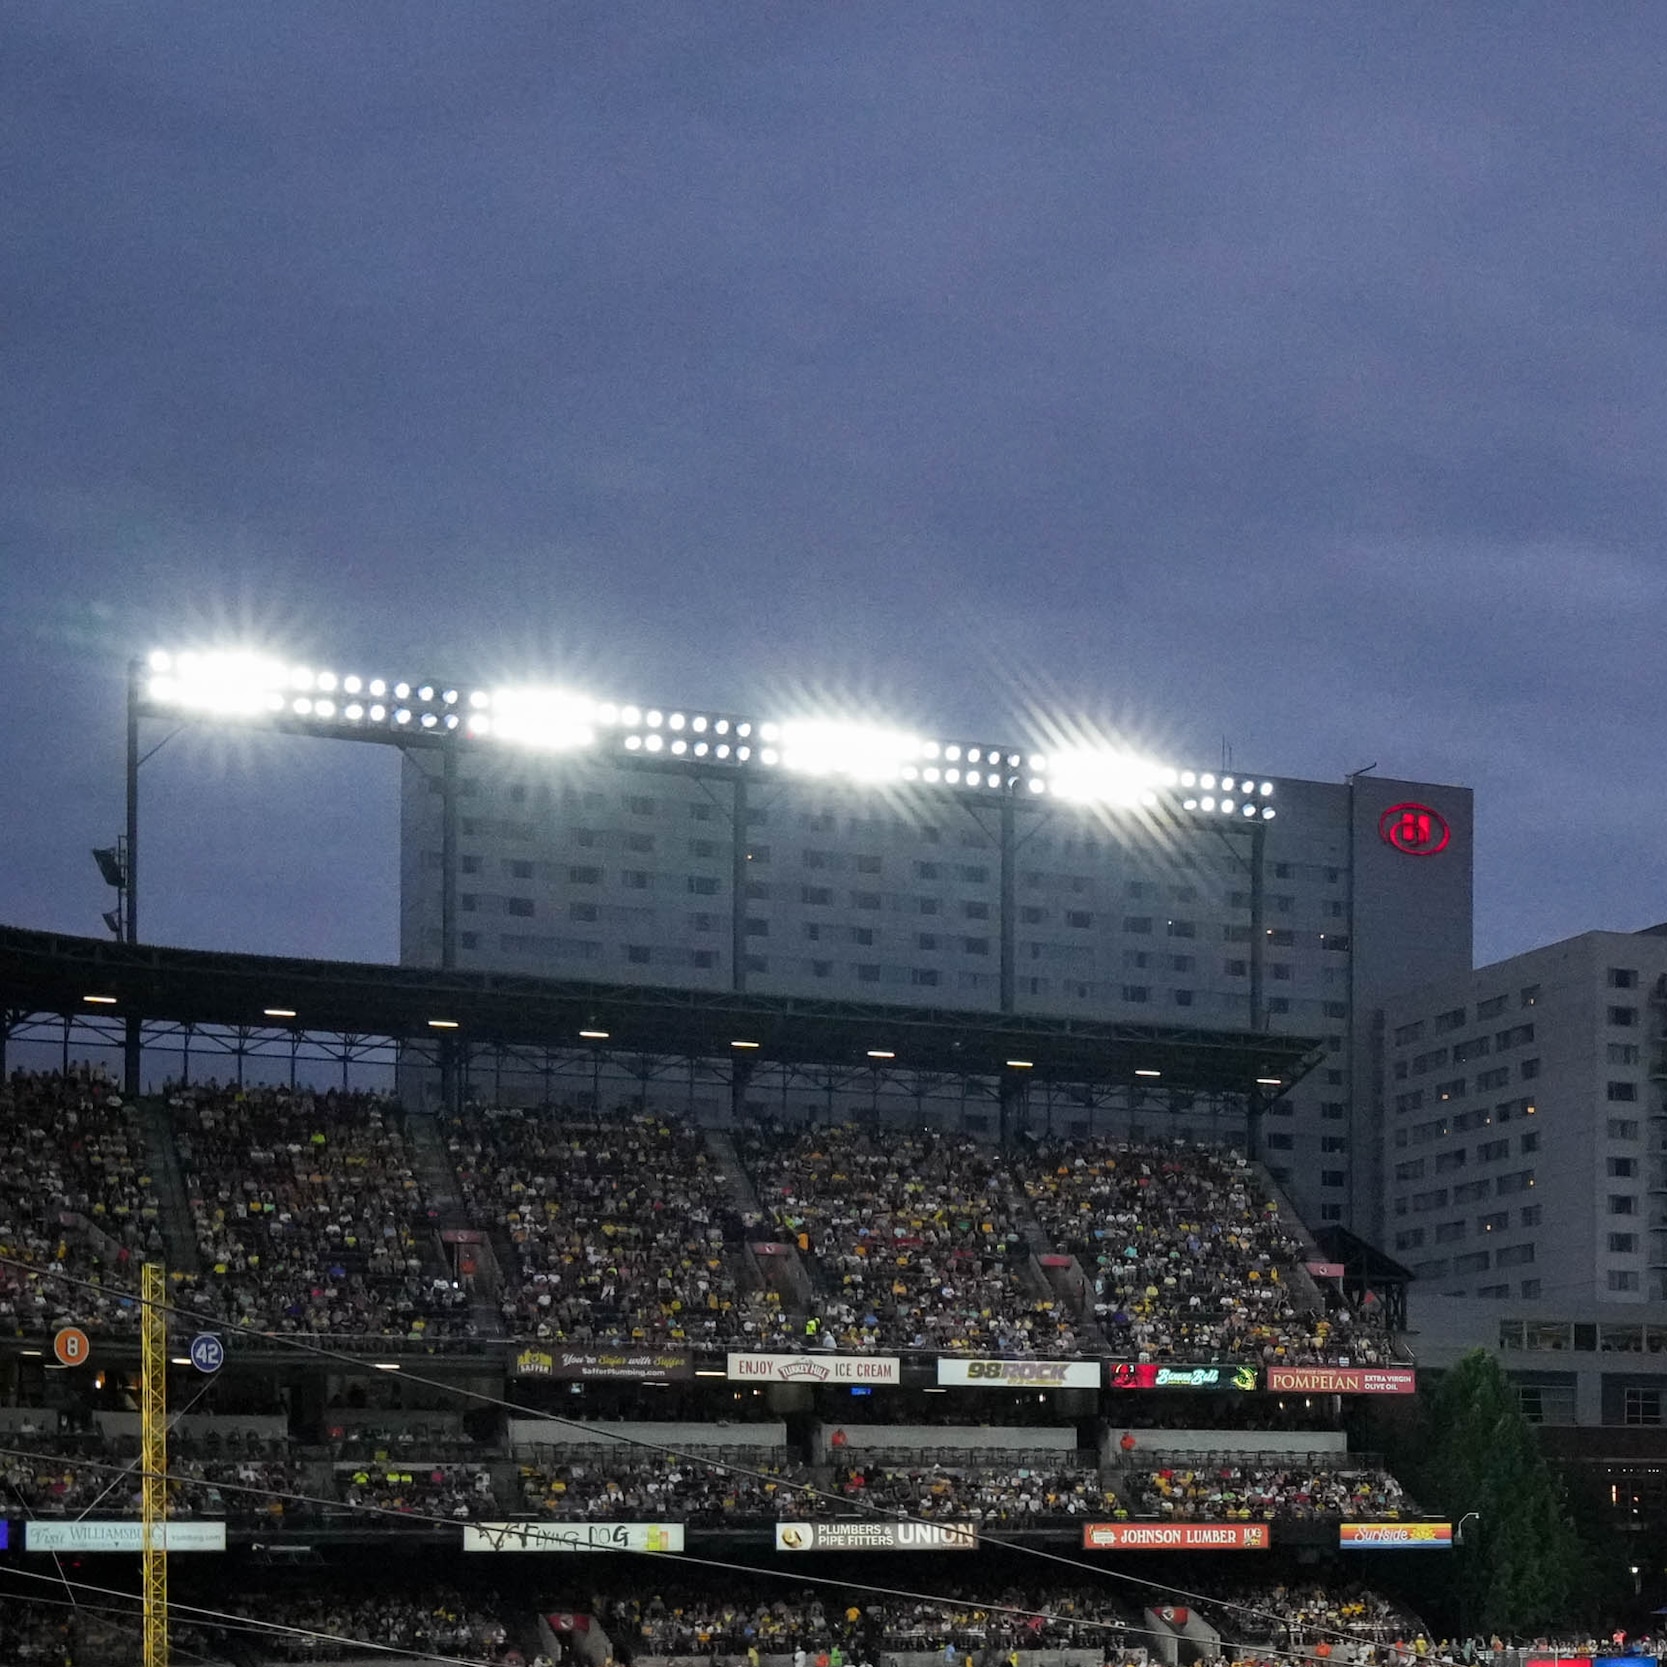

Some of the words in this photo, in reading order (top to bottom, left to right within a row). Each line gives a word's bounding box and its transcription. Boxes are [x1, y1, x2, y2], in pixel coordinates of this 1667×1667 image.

[67, 1336, 79, 1357] 8
[196, 1344, 219, 1364] 42
[562, 1353, 597, 1365] You're
[628, 1355, 652, 1365] with
[582, 1367, 666, 1377] SafferPlumbing.com
[738, 1360, 774, 1375] ENJOY
[834, 1363, 853, 1377] ICE
[856, 1363, 892, 1378] CREAM
[1272, 1374, 1359, 1391] POMPEIAN
[588, 1525, 630, 1550] DOG
[818, 1524, 881, 1535] PLUMBERS
[884, 1526, 892, 1535] &
[897, 1523, 974, 1544] UNION
[1121, 1529, 1182, 1544] JOHNSON
[1186, 1529, 1237, 1544] LUMBER
[1354, 1526, 1409, 1543] Surfside
[818, 1536, 845, 1546] PIPE
[847, 1535, 894, 1546] FITTERS
